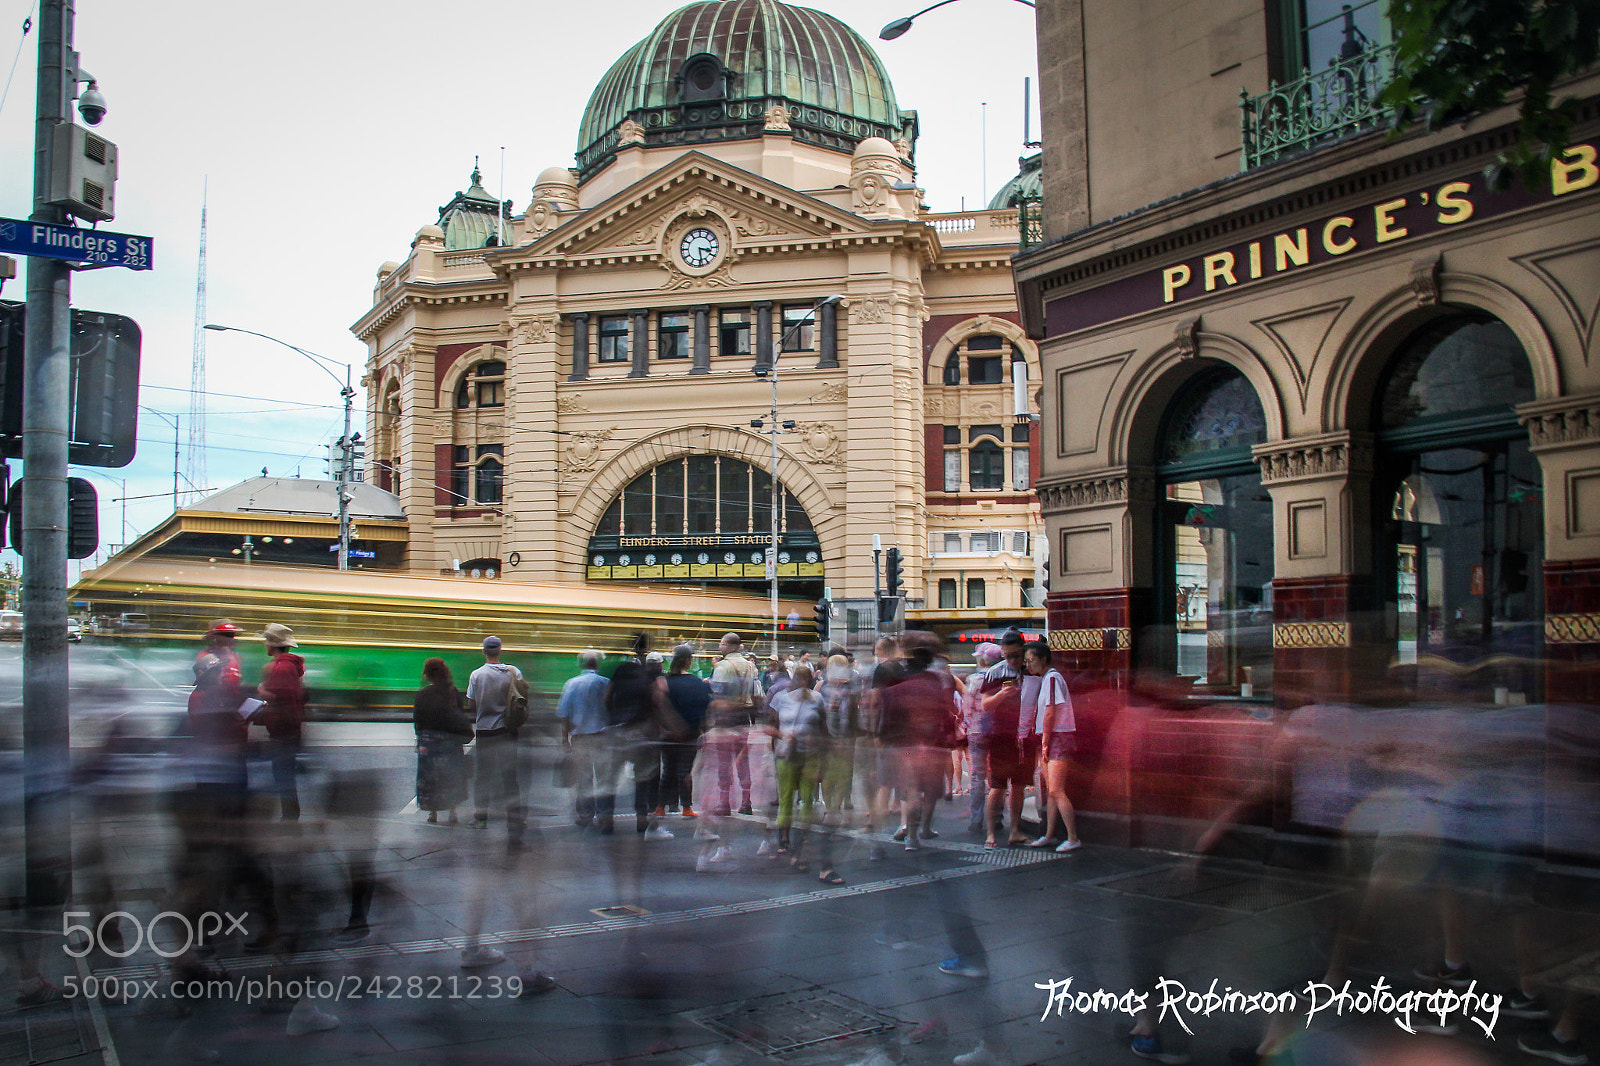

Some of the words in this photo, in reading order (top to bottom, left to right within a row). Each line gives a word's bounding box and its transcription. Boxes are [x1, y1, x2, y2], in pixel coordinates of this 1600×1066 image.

[32, 225, 118, 254] Flinders
[125, 237, 148, 257] St
[1162, 181, 1475, 303] PRINCE'S
[86, 250, 108, 262] 210
[123, 254, 147, 267] 282
[619, 536, 670, 547] FLINDERS
[682, 536, 722, 546] STREET
[971, 633, 995, 642] CITY
